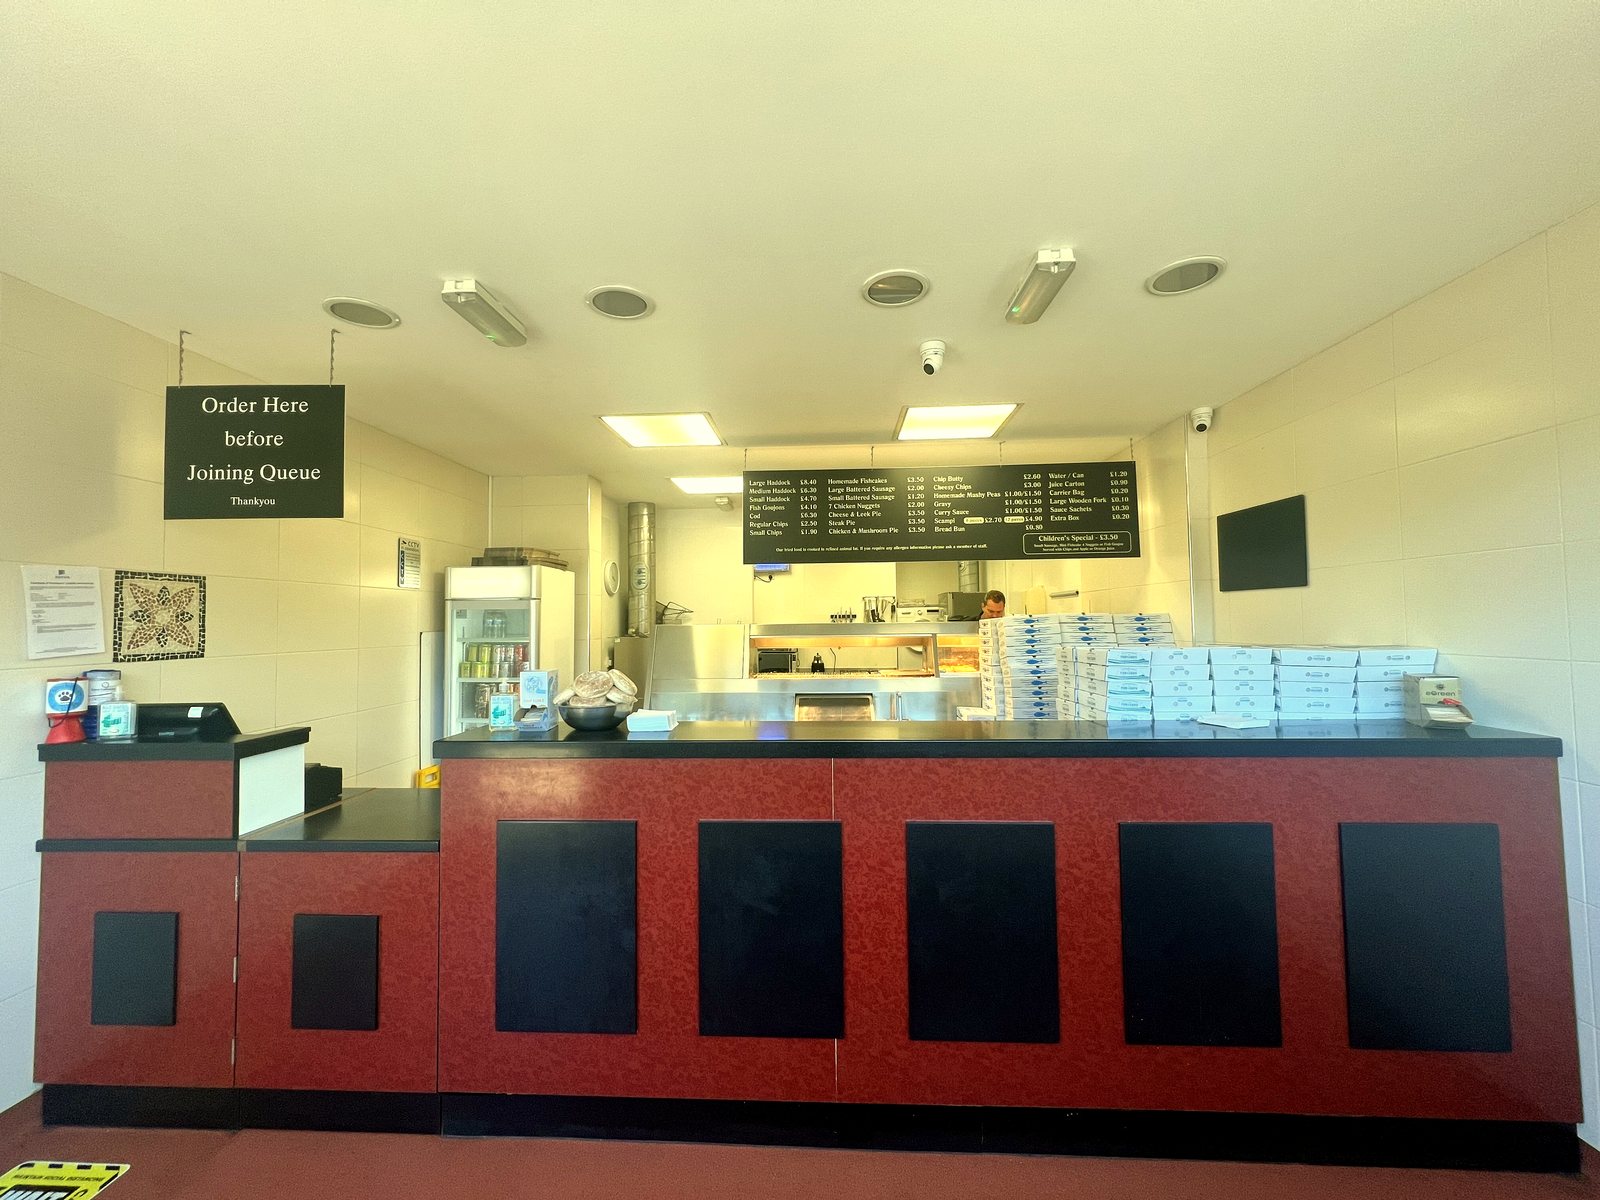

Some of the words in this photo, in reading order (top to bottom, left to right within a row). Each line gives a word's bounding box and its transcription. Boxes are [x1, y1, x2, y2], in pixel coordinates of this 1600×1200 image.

[202, 396, 257, 413] Order
[262, 396, 308, 412] Here
[225, 430, 284, 446] before
[186, 464, 254, 484] Joining
[260, 464, 320, 482] Queue
[230, 496, 276, 507] Thankyou
